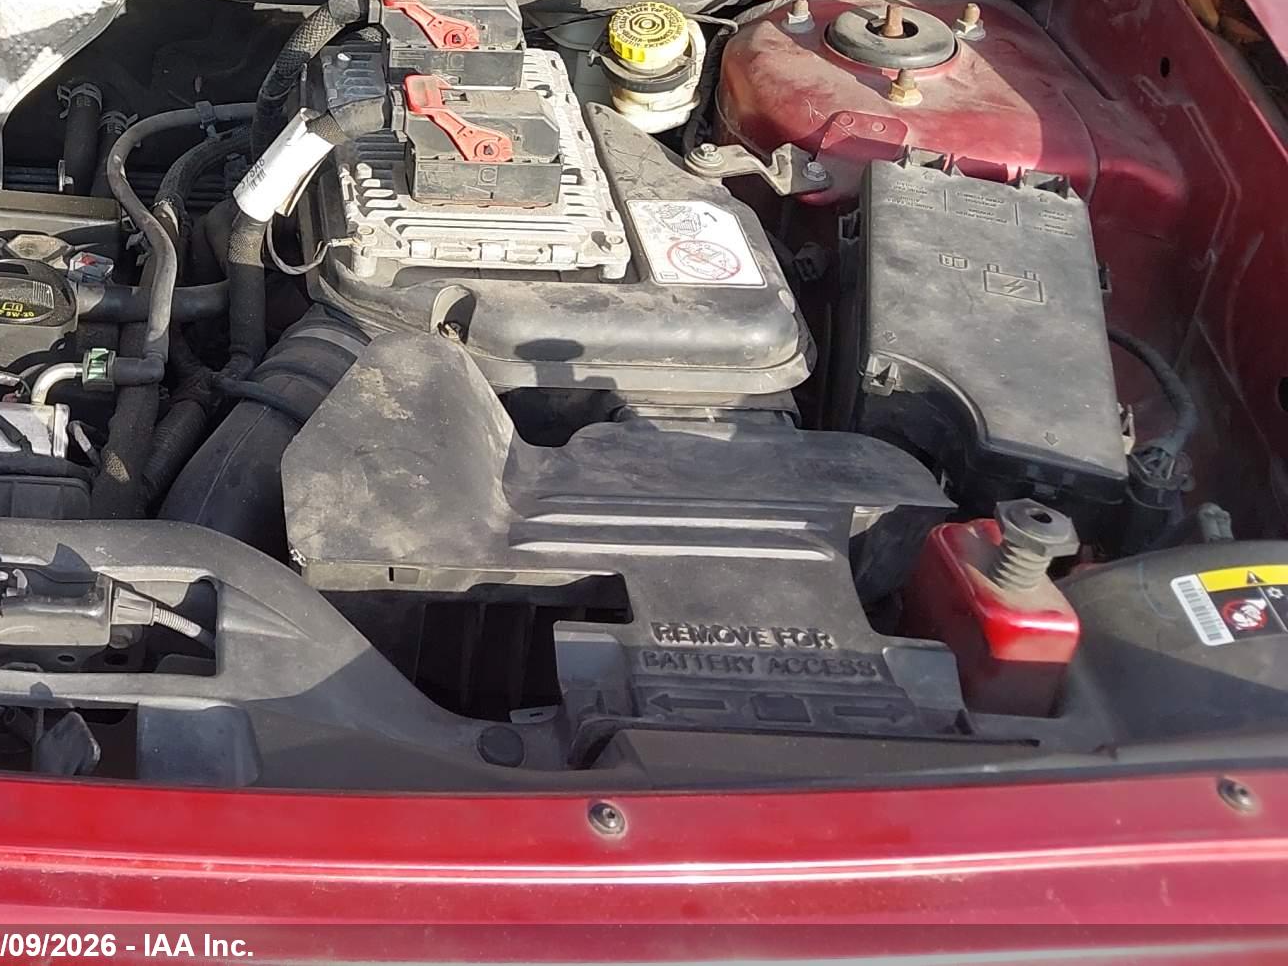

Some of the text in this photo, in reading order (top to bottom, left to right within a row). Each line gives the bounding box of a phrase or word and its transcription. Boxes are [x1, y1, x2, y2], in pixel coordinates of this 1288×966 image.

[651, 621, 837, 650] REMOVE FOR
[641, 650, 878, 678] BATTERY ACCESS
